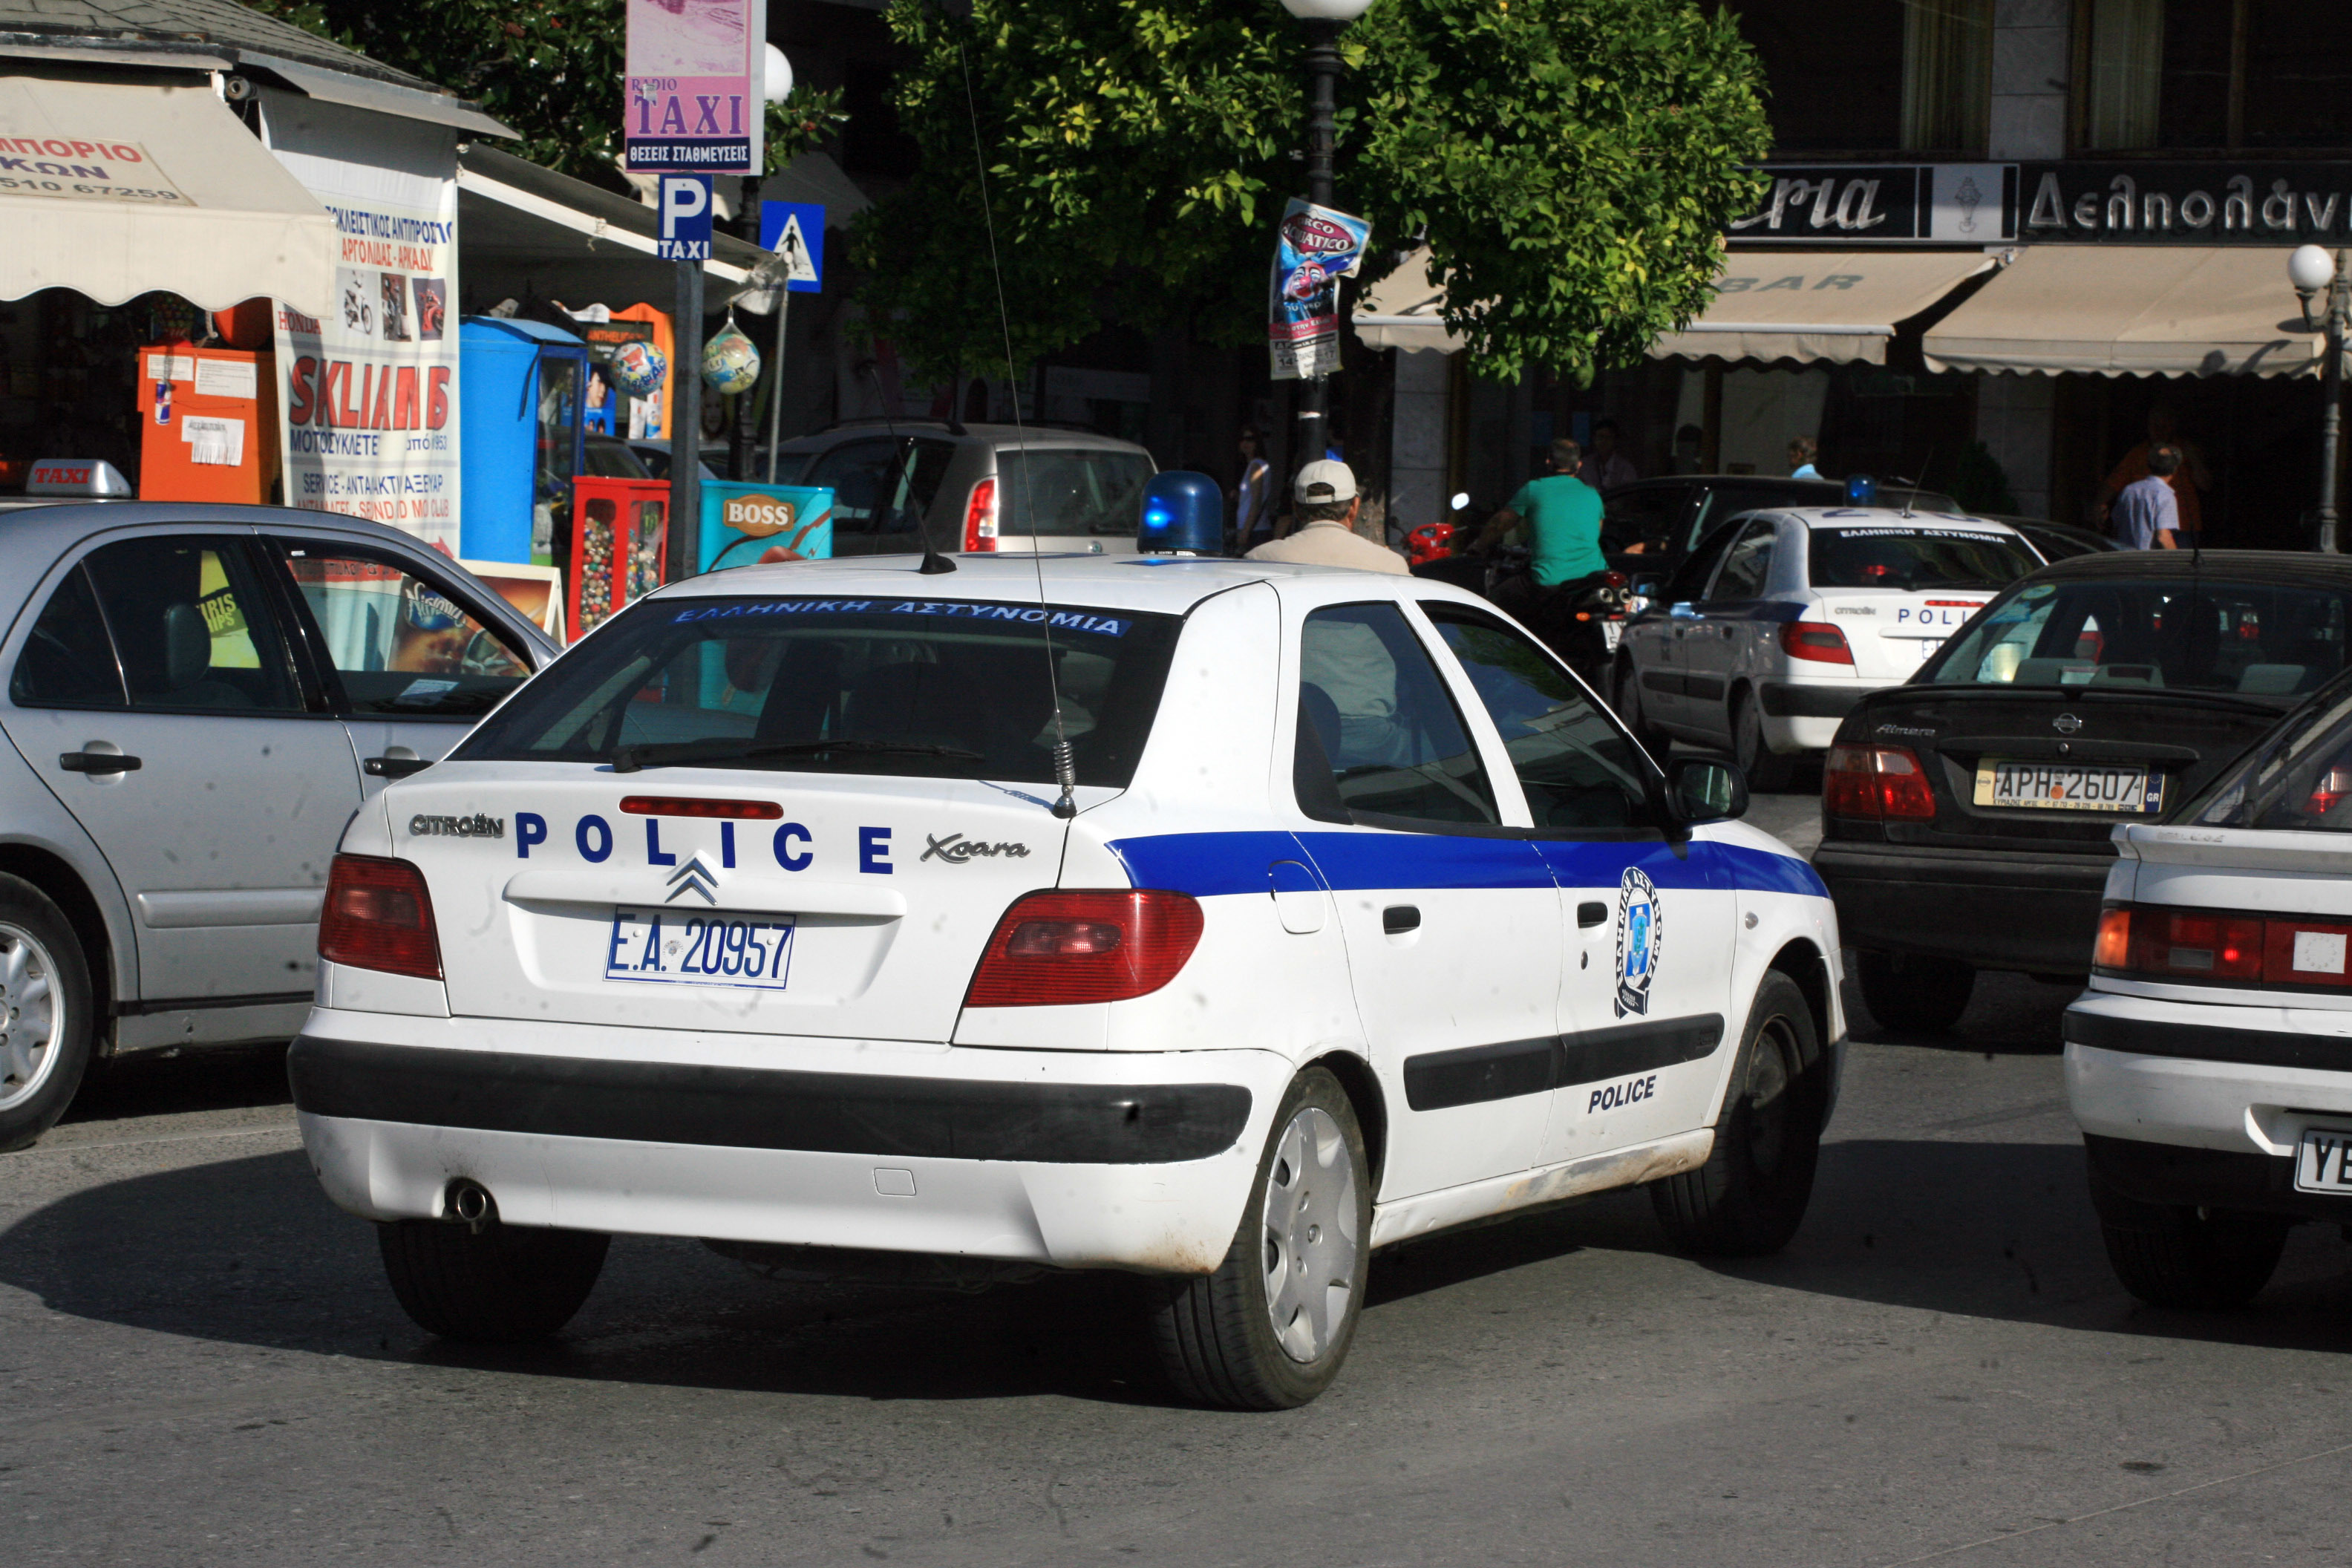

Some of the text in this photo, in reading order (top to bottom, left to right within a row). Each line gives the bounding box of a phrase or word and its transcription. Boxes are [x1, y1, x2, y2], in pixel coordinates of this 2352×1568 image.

[634, 95, 742, 134] TAXI
[630, 146, 748, 162] ΘΕΣΕΙΣ ΣΤΑΘΜΕΥΣΕΙΣ
[74, 184, 179, 200] 67259
[664, 178, 707, 238] P
[659, 240, 709, 259] TAXI
[1717, 275, 1864, 293] BAR
[278, 311, 321, 335] HONDA
[35, 468, 91, 483] TAXI
[728, 503, 789, 526] BOSS
[1840, 529, 2006, 543] ΕΛΛΗΝΙΚΗ ΑΣΤΥΝΟΜΙΑ
[195, 593, 237, 620] IRIS
[675, 601, 1119, 635] ΕΛΛΗΝΙΚΗ ΑΣΤΥΝΟΜΙΑ
[2146, 792, 2159, 803] GR
[408, 812, 1031, 874] CITROËN POLICE Xsara
[1633, 870, 1662, 979] ΑΣΤΥΝΟΜΙΑ
[610, 913, 792, 978] E.A. 20957
[1588, 1075, 1656, 1114] POLICE
